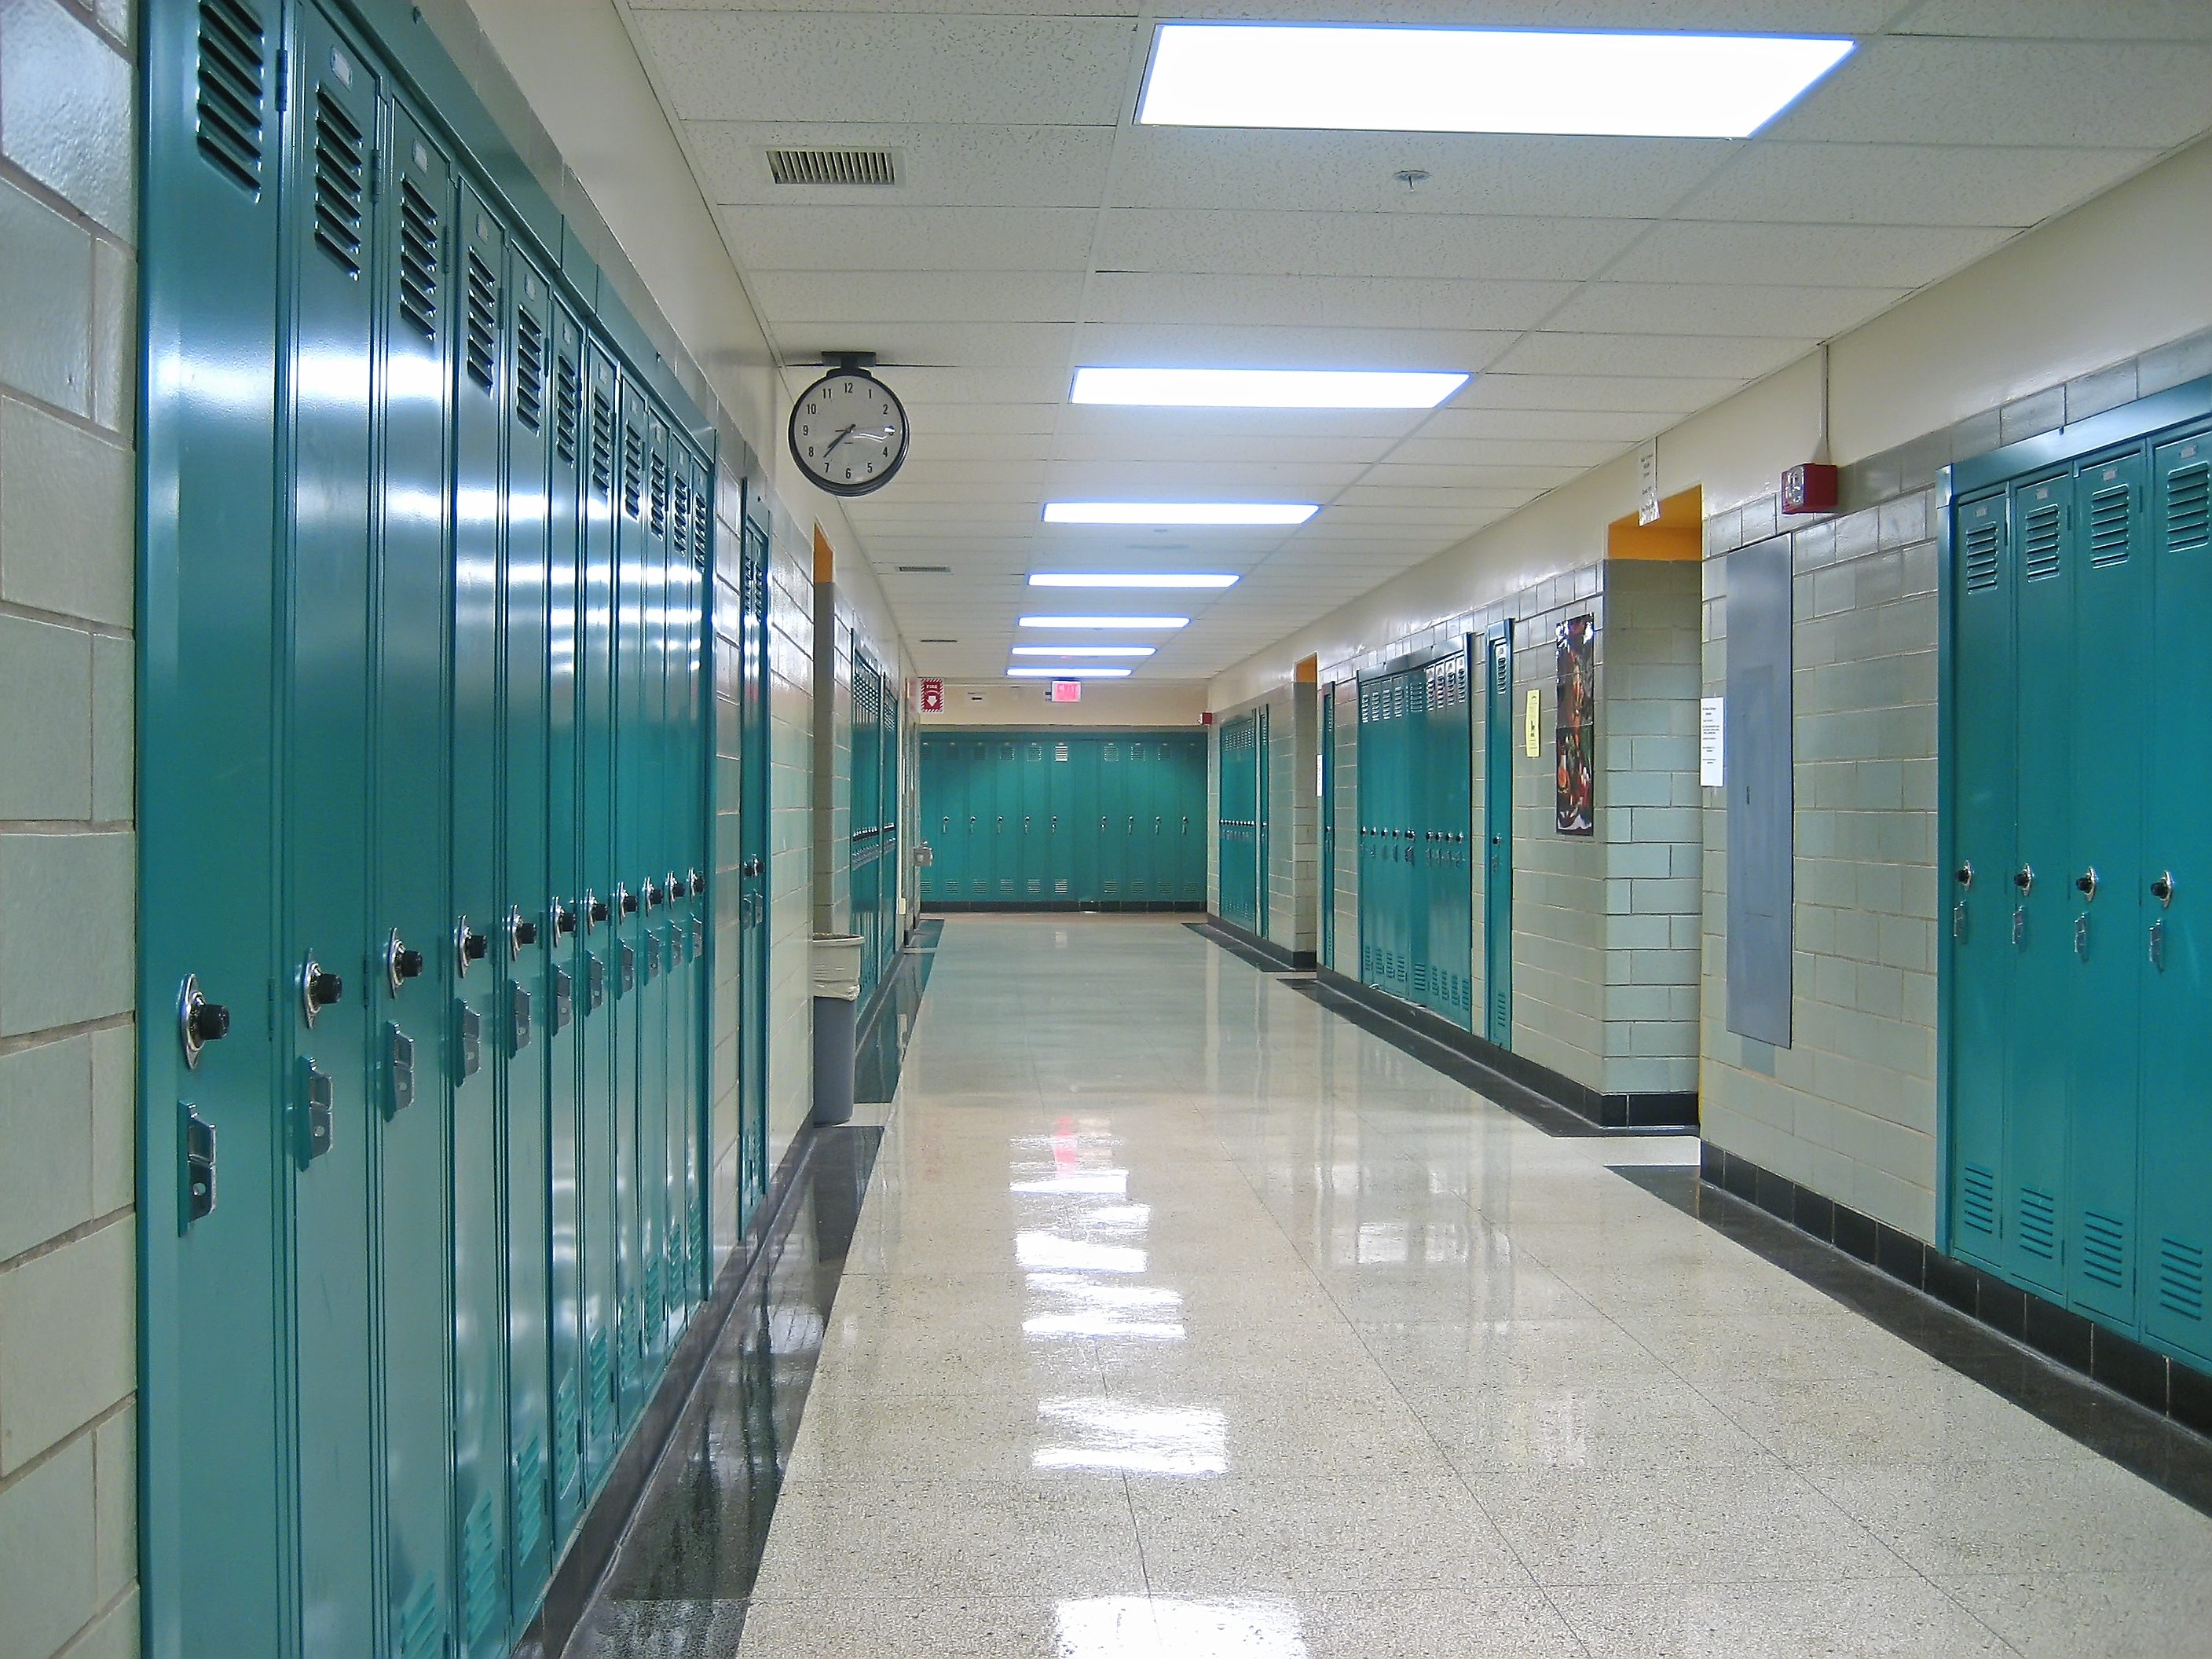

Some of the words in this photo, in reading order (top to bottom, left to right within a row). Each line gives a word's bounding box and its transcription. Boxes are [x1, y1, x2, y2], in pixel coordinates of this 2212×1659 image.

[822, 388, 831, 399] 11
[844, 383, 853, 394] 12
[869, 388, 872, 399] 1
[807, 404, 816, 415] 10
[882, 404, 888, 415] 2
[803, 425, 808, 436] 9
[808, 446, 814, 457] 8
[882, 446, 888, 457] 4
[824, 462, 830, 473] 7
[845, 467, 851, 479] 6
[867, 462, 873, 473] 5
